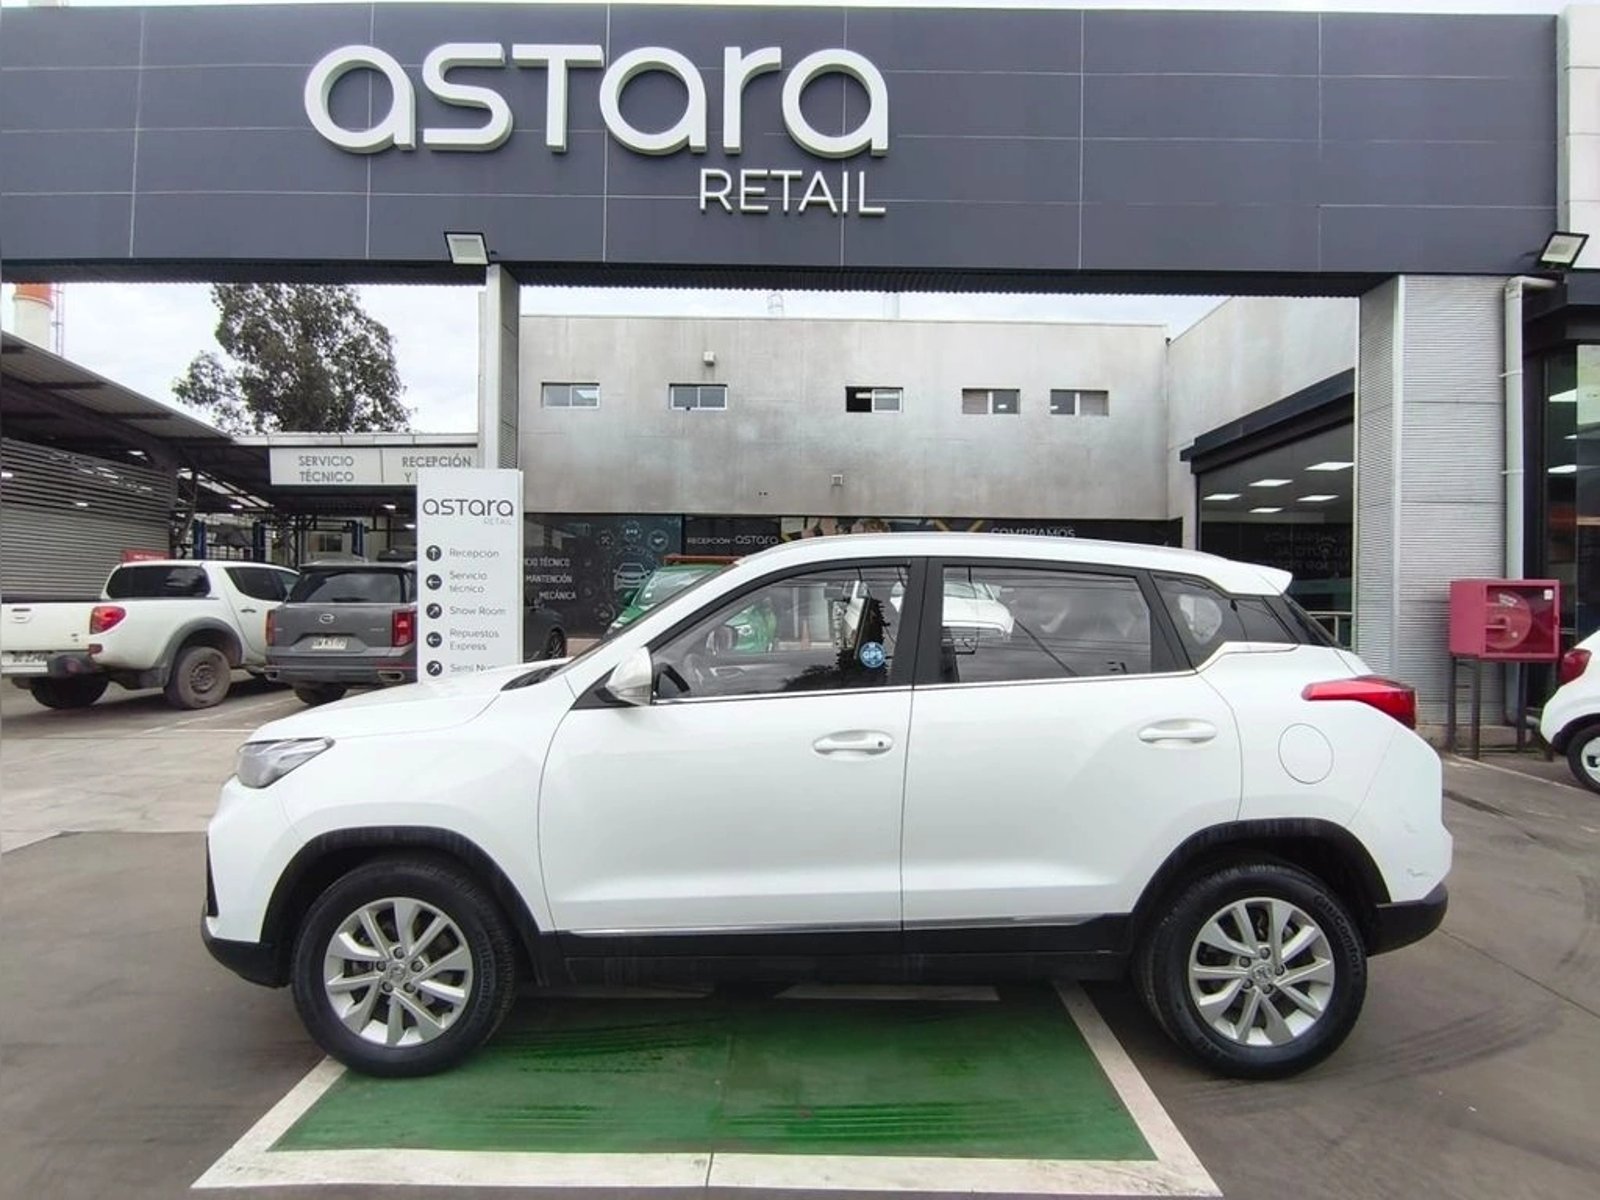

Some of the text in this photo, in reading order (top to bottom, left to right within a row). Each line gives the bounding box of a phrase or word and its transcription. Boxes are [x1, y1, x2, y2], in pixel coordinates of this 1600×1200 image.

[699, 168, 887, 216] RETAIL
[298, 455, 354, 466] SERVICIO
[402, 453, 472, 467] RECEPCIÓN
[299, 469, 355, 482] TÉCNICO
[404, 472, 412, 482] Y
[539, 556, 571, 567] TÉCNICO
[449, 571, 488, 581] Servicio
[526, 573, 573, 584] MANTENCIÓN
[449, 584, 485, 593] técnico
[538, 589, 577, 600] MECÁNICA
[449, 606, 507, 615] Show Room
[449, 629, 500, 640] Repuestos
[449, 643, 487, 652] Express
[449, 664, 475, 672] Semi
